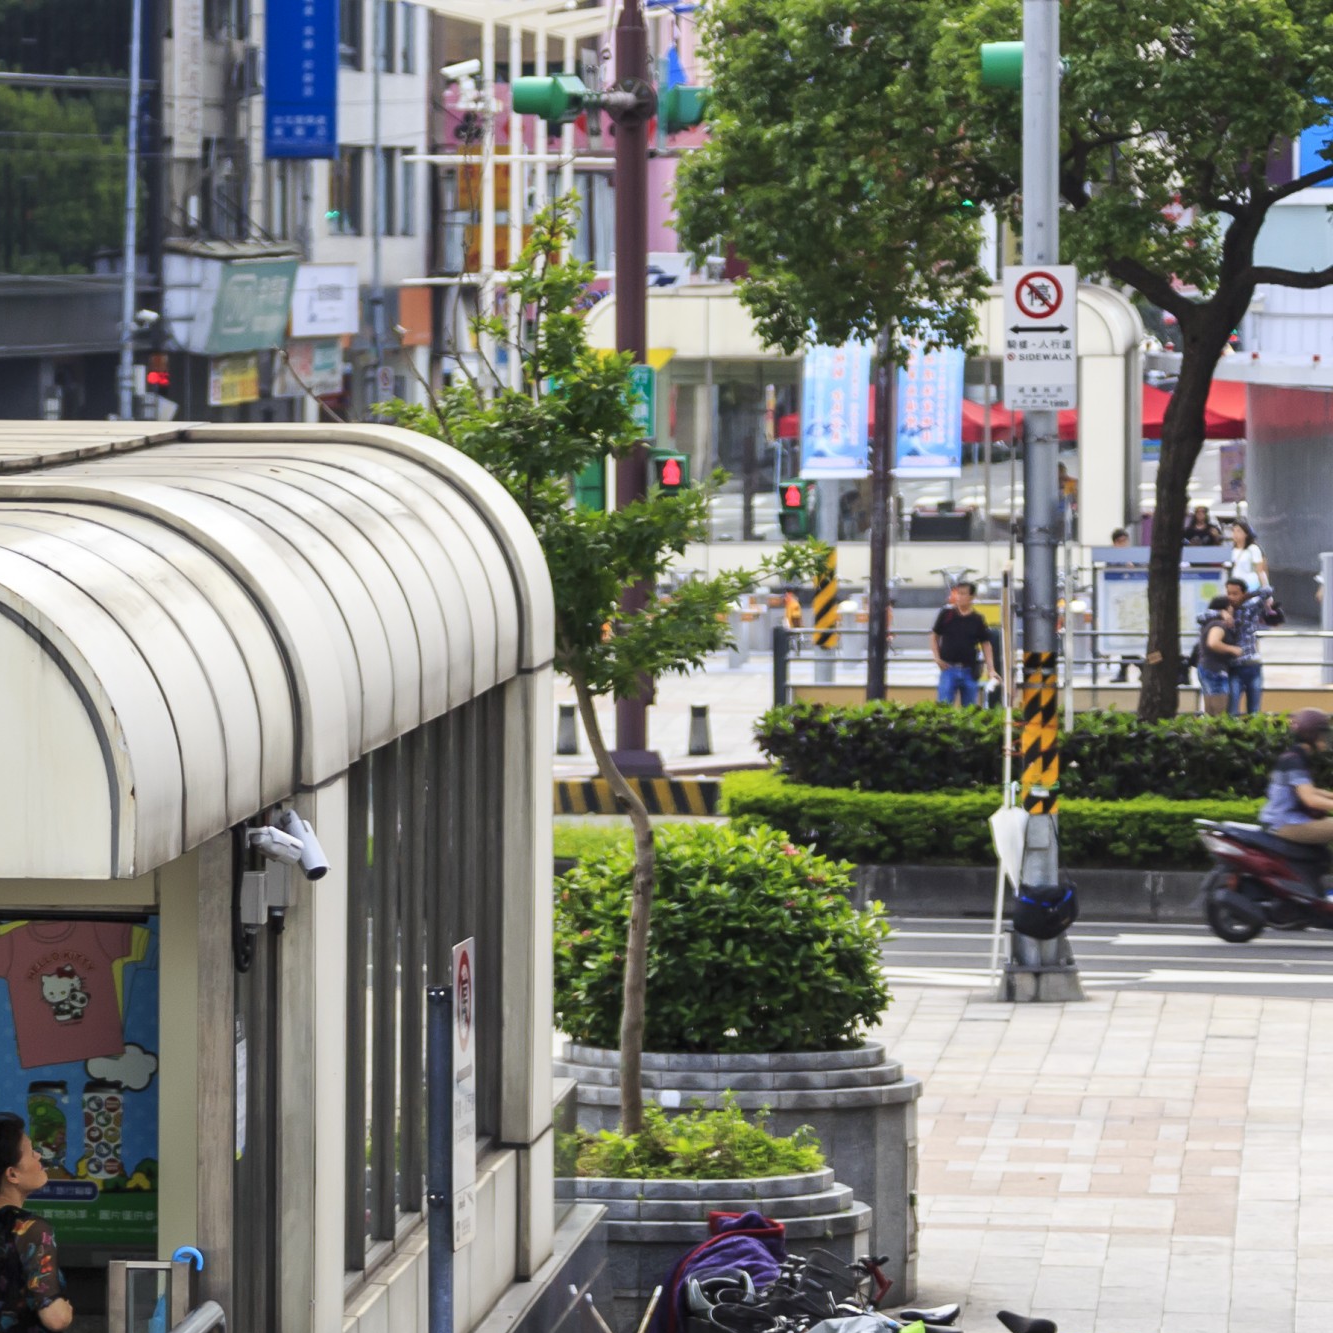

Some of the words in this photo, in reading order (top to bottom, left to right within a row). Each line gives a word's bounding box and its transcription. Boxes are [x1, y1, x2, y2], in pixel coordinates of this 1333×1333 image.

[1019, 353, 1072, 361] SIDEWALK
[27, 950, 61, 979] HELLO
[61, 949, 96, 972] KITTY
